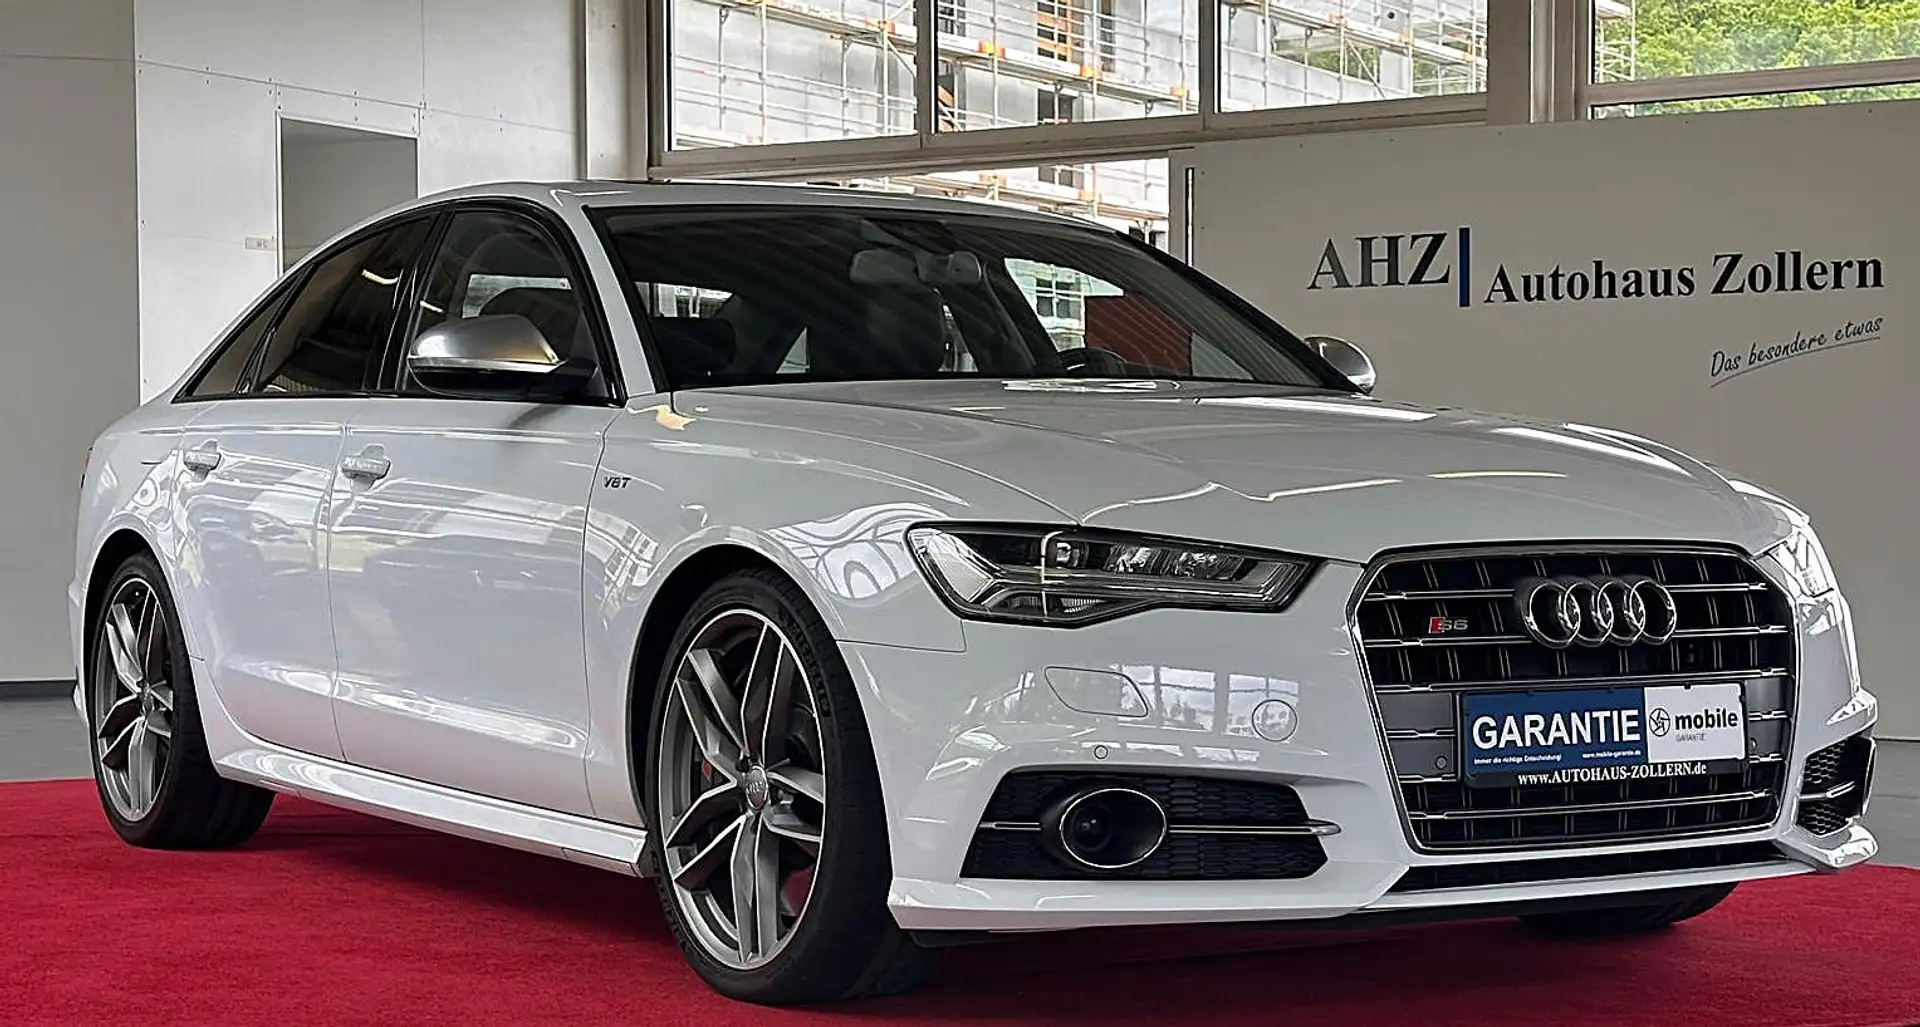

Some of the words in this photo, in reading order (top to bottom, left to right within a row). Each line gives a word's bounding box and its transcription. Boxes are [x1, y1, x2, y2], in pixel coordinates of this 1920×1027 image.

[1307, 232, 1451, 290] AHZ
[1484, 260, 1695, 303] Autohaus
[1711, 251, 1885, 295] Zollern
[1711, 350, 1740, 378] Das
[1748, 330, 1828, 369] besondere
[1834, 316, 1884, 342] etwas
[1472, 709, 1641, 750] GARANTIE
[1675, 708, 1739, 730] mobile
[1518, 762, 1707, 786] www.AUTOHAUS-ZOLLERN.de
